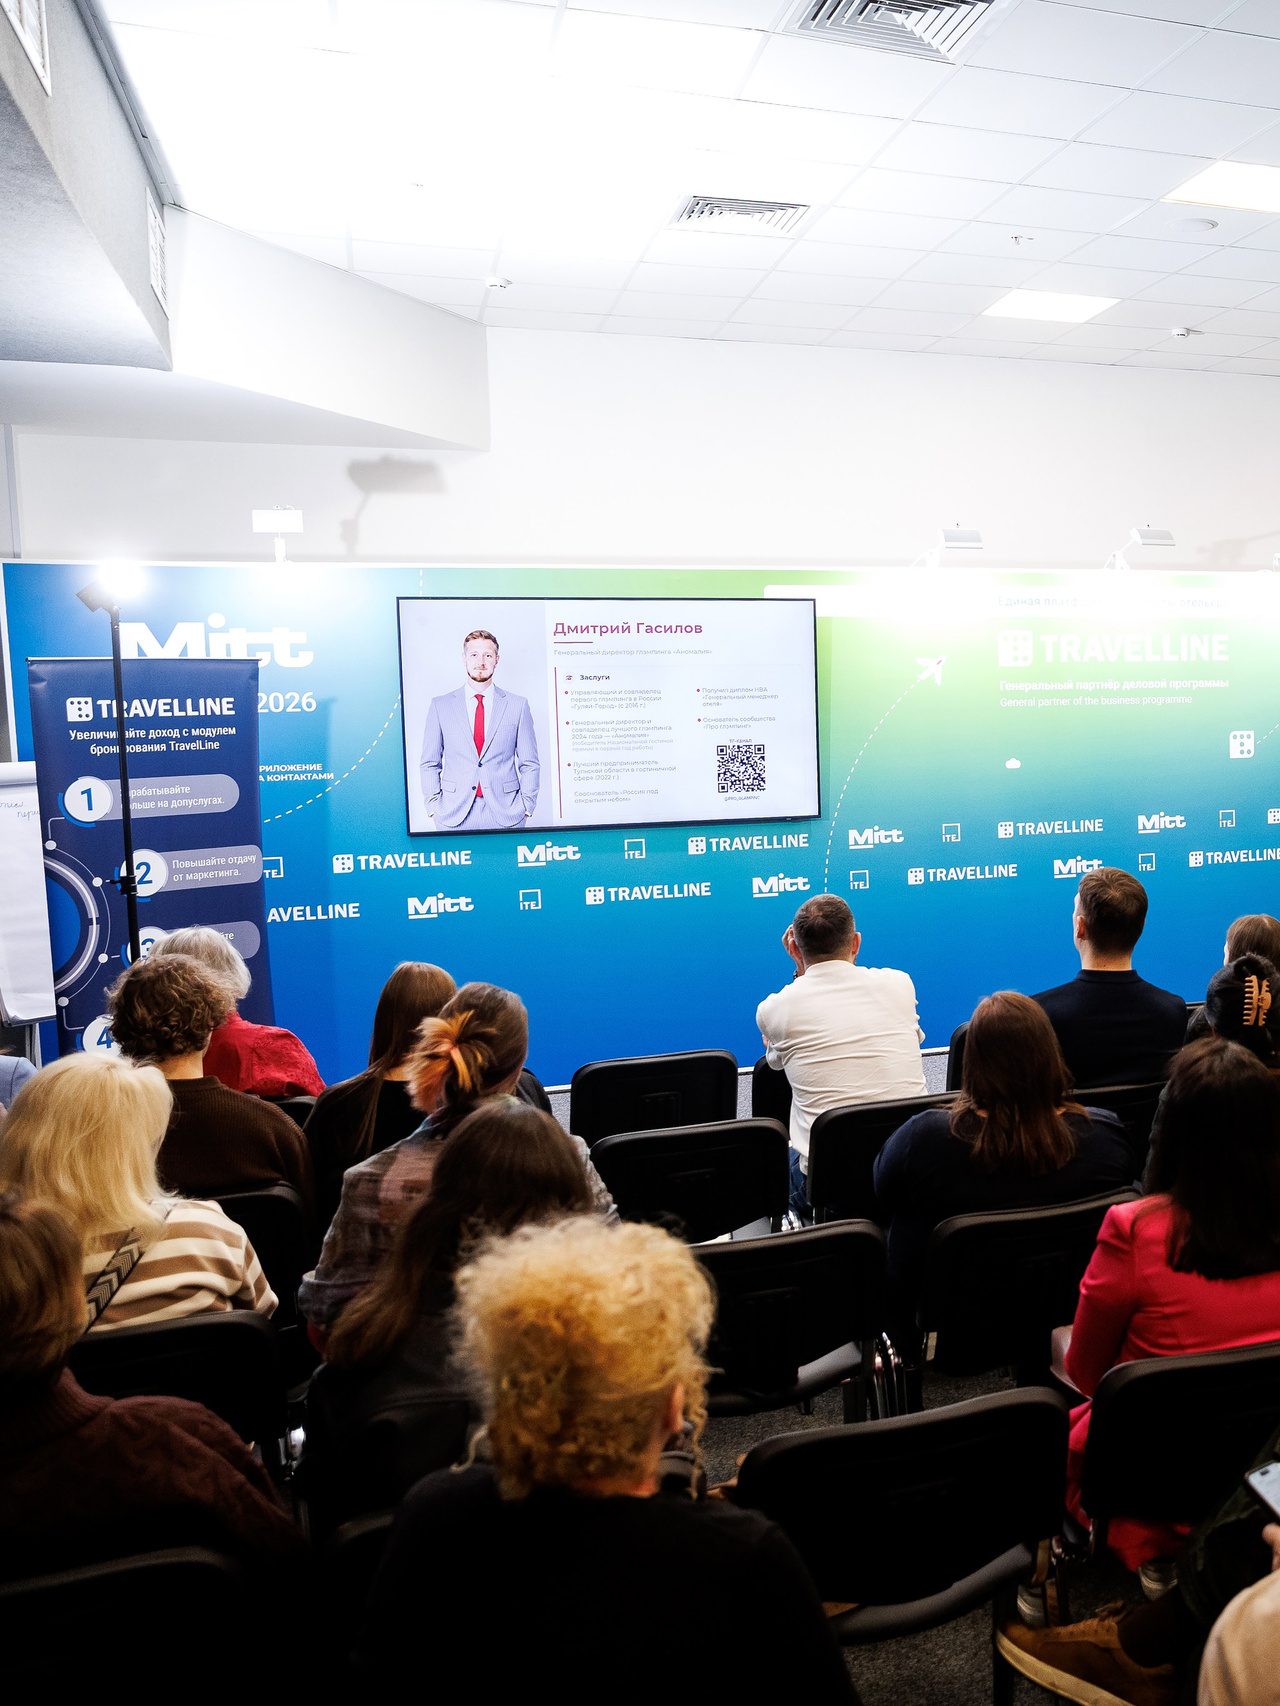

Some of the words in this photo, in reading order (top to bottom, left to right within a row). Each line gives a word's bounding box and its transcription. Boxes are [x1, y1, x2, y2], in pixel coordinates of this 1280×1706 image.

[553, 622, 631, 637] Дмитрий
[636, 622, 703, 634] Гасилов
[117, 613, 314, 668] Mitt
[1039, 633, 1230, 663] TRAVELLINE
[579, 674, 610, 682] Заслуги
[999, 680, 1074, 693] Генеральный
[1076, 679, 1120, 692] партнёр
[1122, 679, 1167, 690] деловой
[1169, 679, 1229, 691] программы
[96, 697, 236, 719] TRAVELLINE
[1000, 696, 1036, 707] General
[1038, 697, 1071, 708] partner
[1073, 696, 1082, 706] of
[1084, 696, 1099, 706] the
[1101, 695, 1141, 705] business
[1142, 695, 1193, 707] programme
[69, 727, 146, 741] Увеличиайте
[148, 728, 181, 739] доход
[182, 728, 189, 736] с
[191, 727, 236, 738] модулем
[168, 739, 220, 751] TravelLine
[259, 763, 323, 772] РИЛОЖЕНИЕ
[266, 772, 334, 782] КОНТАКТАМИ
[80, 787, 93, 811] 1
[120, 784, 191, 798] рабатывайте
[120, 801, 156, 810] ольше
[170, 796, 225, 809] допуслугах.
[1137, 811, 1187, 831] Mitt
[848, 825, 904, 846] Mitt
[1016, 818, 1104, 836] TRAVELLINE
[517, 841, 581, 864] Mitt
[709, 833, 809, 853] TRAVELLINE
[172, 854, 226, 869] Повышайте
[227, 854, 257, 866] отдачу
[356, 850, 472, 871] TRAVELLINE
[927, 863, 1018, 882] TRAVELLINE
[1053, 855, 1105, 876] Mitt
[136, 861, 153, 885] 2
[173, 872, 184, 882] от
[185, 868, 242, 882] маркетинга.
[607, 882, 712, 902] TRAVELLINE
[752, 873, 811, 895] Mitt
[267, 902, 361, 923] AVELLINE
[407, 892, 475, 917] Mitt
[96, 1026, 114, 1049] 4
